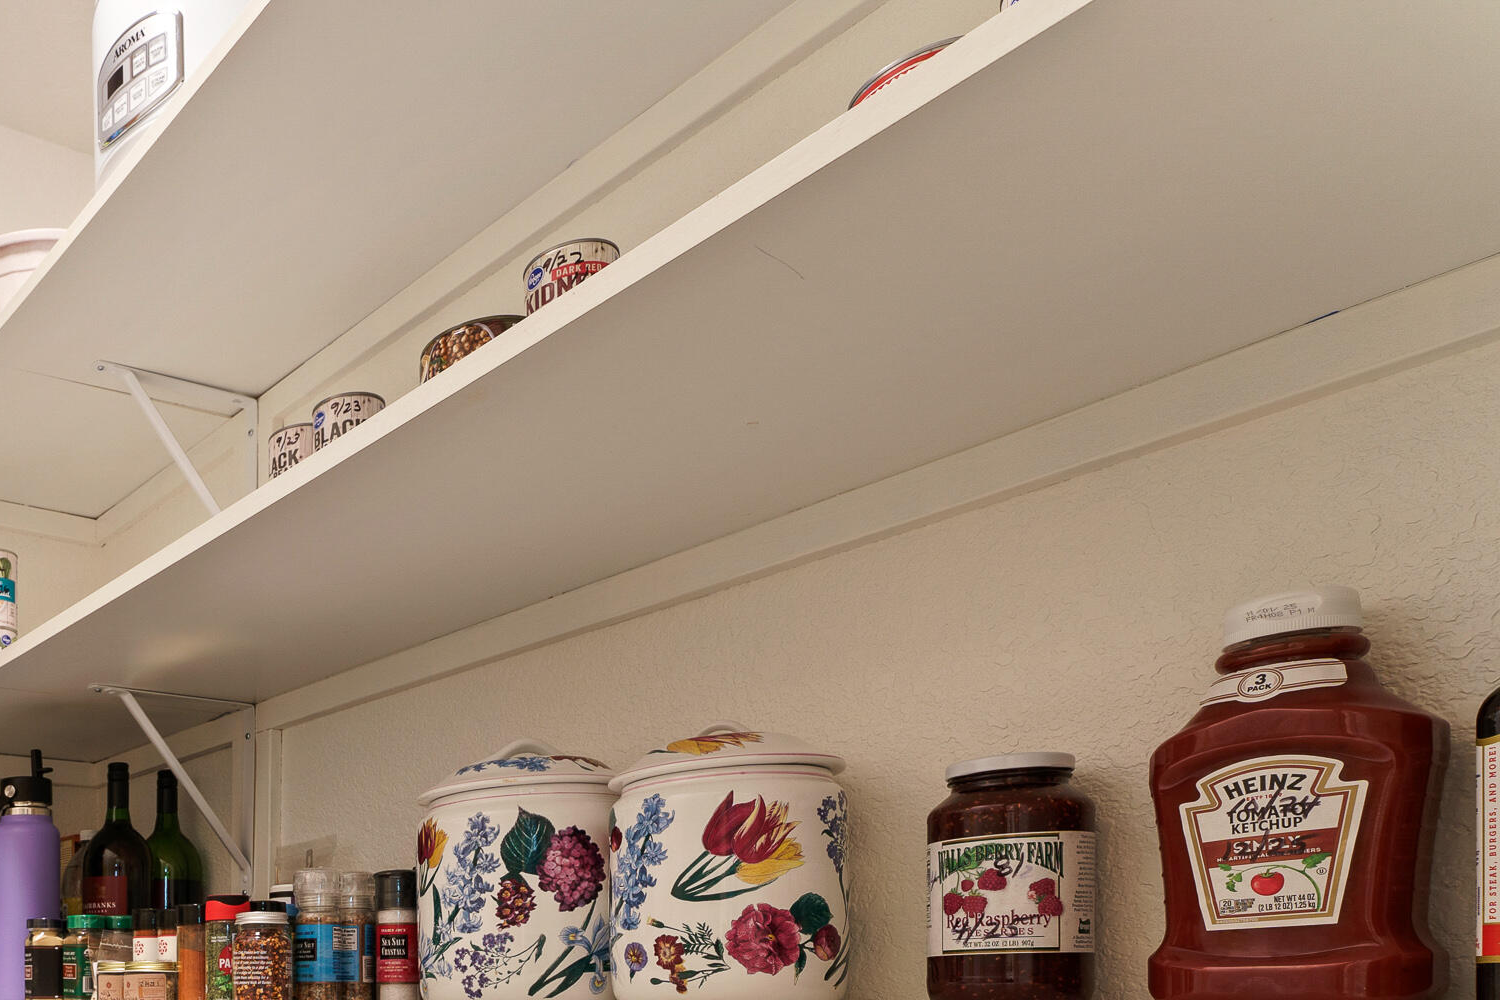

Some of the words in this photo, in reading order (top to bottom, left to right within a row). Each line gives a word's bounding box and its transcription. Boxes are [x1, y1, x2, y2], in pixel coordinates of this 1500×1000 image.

[113, 28, 145, 63] AROMA
[331, 398, 361, 417] 9/23
[276, 431, 300, 452] 9/23
[1247, 683, 1272, 693] PACK
[1255, 674, 1267, 685] 3
[1489, 746, 1497, 779] MORE!
[1223, 773, 1308, 800] HEINZ
[1489, 782, 1497, 803] AND
[1228, 802, 1307, 825] TOMATO
[1231, 816, 1303, 836] KETCHUP
[1489, 808, 1499, 857] BURGERS,
[938, 847, 972, 885] WALLS
[975, 842, 1024, 861] BERRY
[1027, 841, 1065, 879] FARM
[1489, 861, 1499, 901] STEAK,
[1258, 904, 1265, 913] (2
[1266, 903, 1273, 912] LB
[1274, 902, 1281, 911] 12
[1282, 902, 1294, 911] OZ)
[1294, 901, 1306, 910] 1.25
[1274, 895, 1285, 903] NET
[1286, 895, 1297, 903] WT
[1298, 894, 1306, 902] 44
[1307, 893, 1316, 901] OZ
[975, 909, 1051, 928] Raspberry
[1489, 905, 1498, 920] FOR
